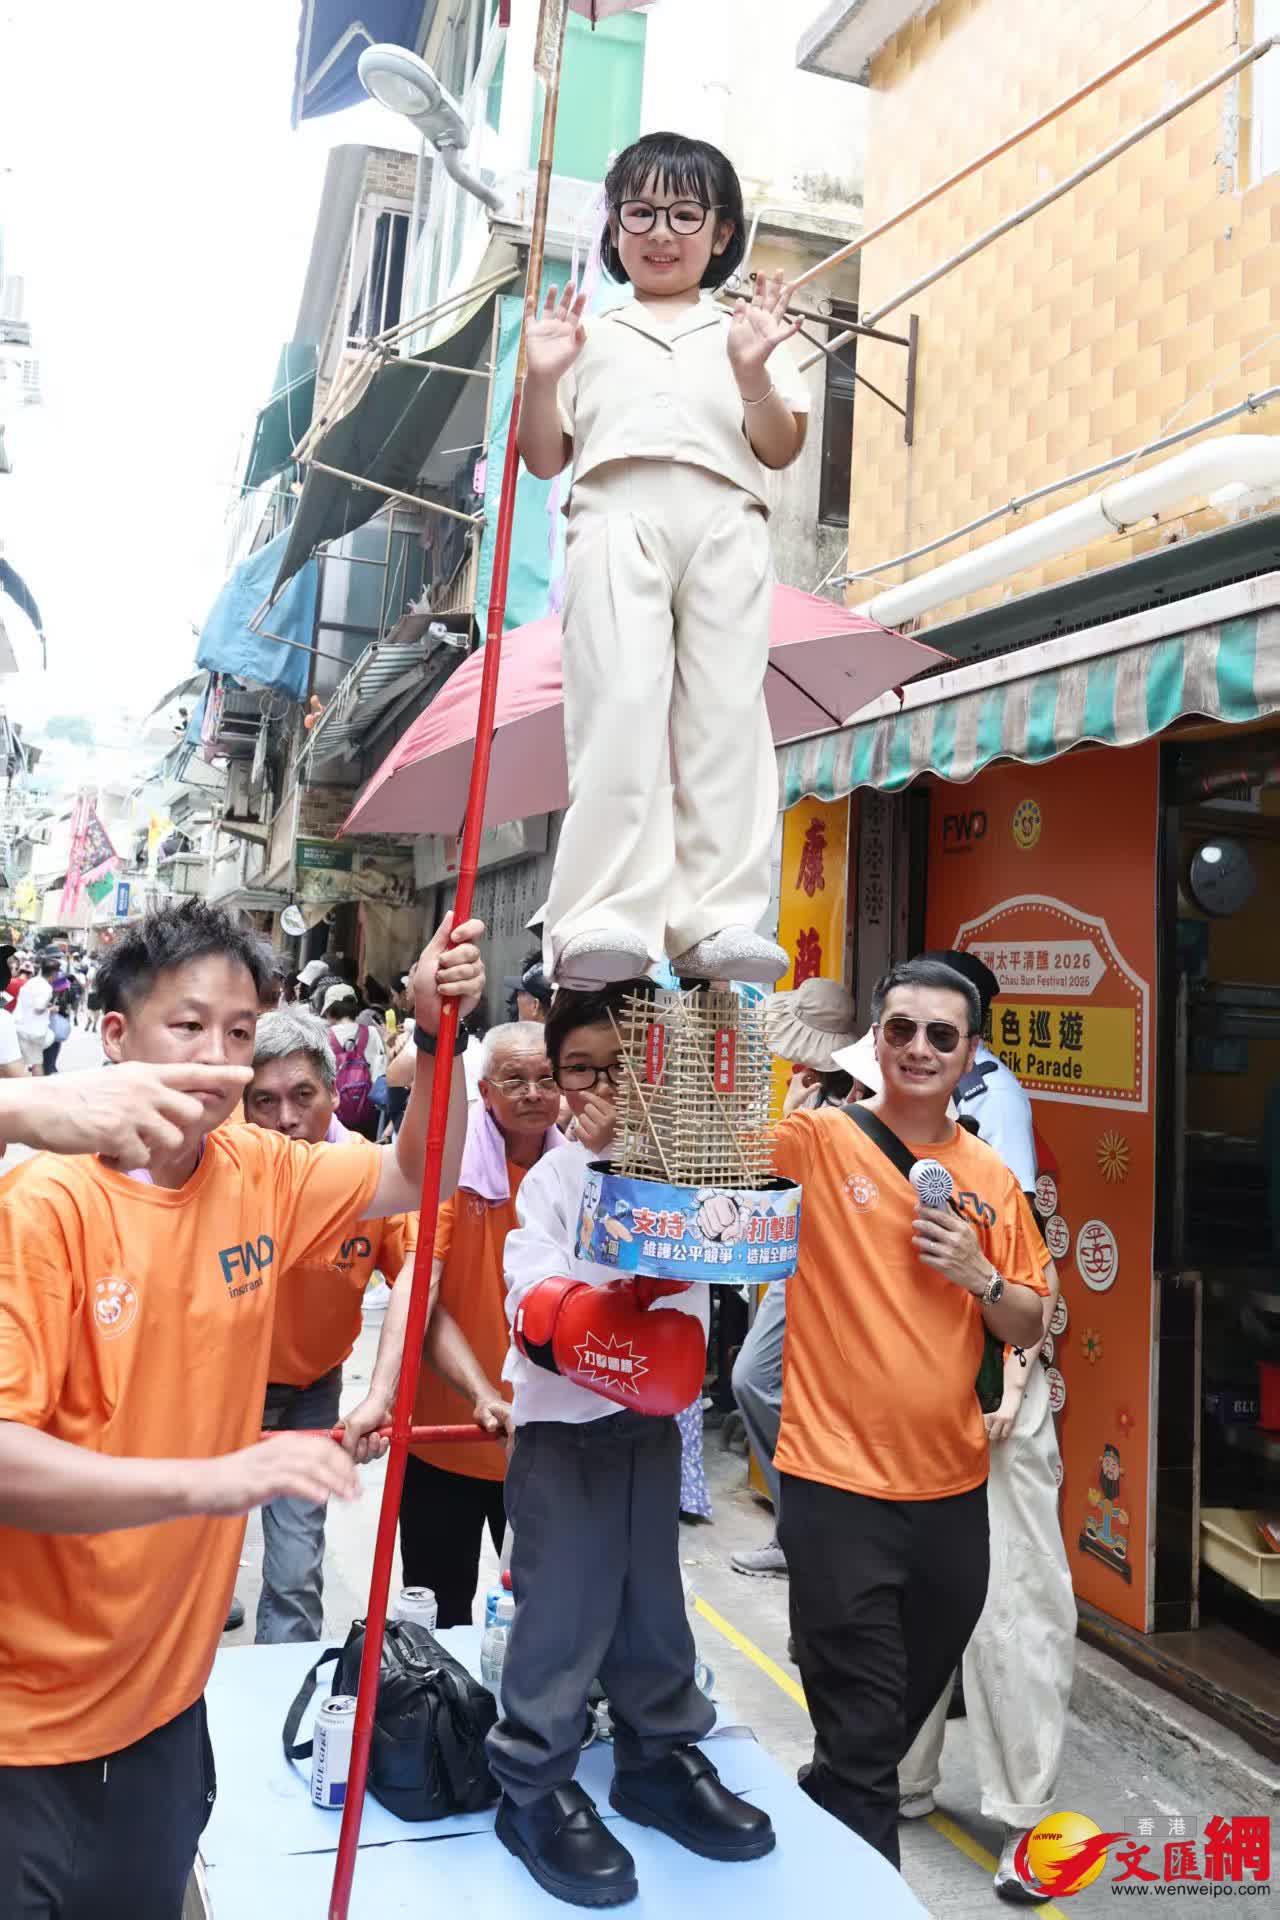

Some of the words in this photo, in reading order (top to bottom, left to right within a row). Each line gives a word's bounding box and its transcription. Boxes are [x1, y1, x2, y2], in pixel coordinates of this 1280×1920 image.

[943, 811, 988, 841] FWD
[972, 950, 1048, 971] 洲太平清醮
[1054, 953, 1090, 969] 2026
[1000, 975, 1019, 986] Chau
[1021, 975, 1034, 986] Bun
[1038, 975, 1068, 988] Festival
[1069, 976, 1090, 987] 2026
[1027, 1054, 1083, 1080] Parade
[630, 1207, 687, 1240] 支持
[218, 1234, 275, 1284] FWD
[314, 1766, 325, 1801] BLUE
